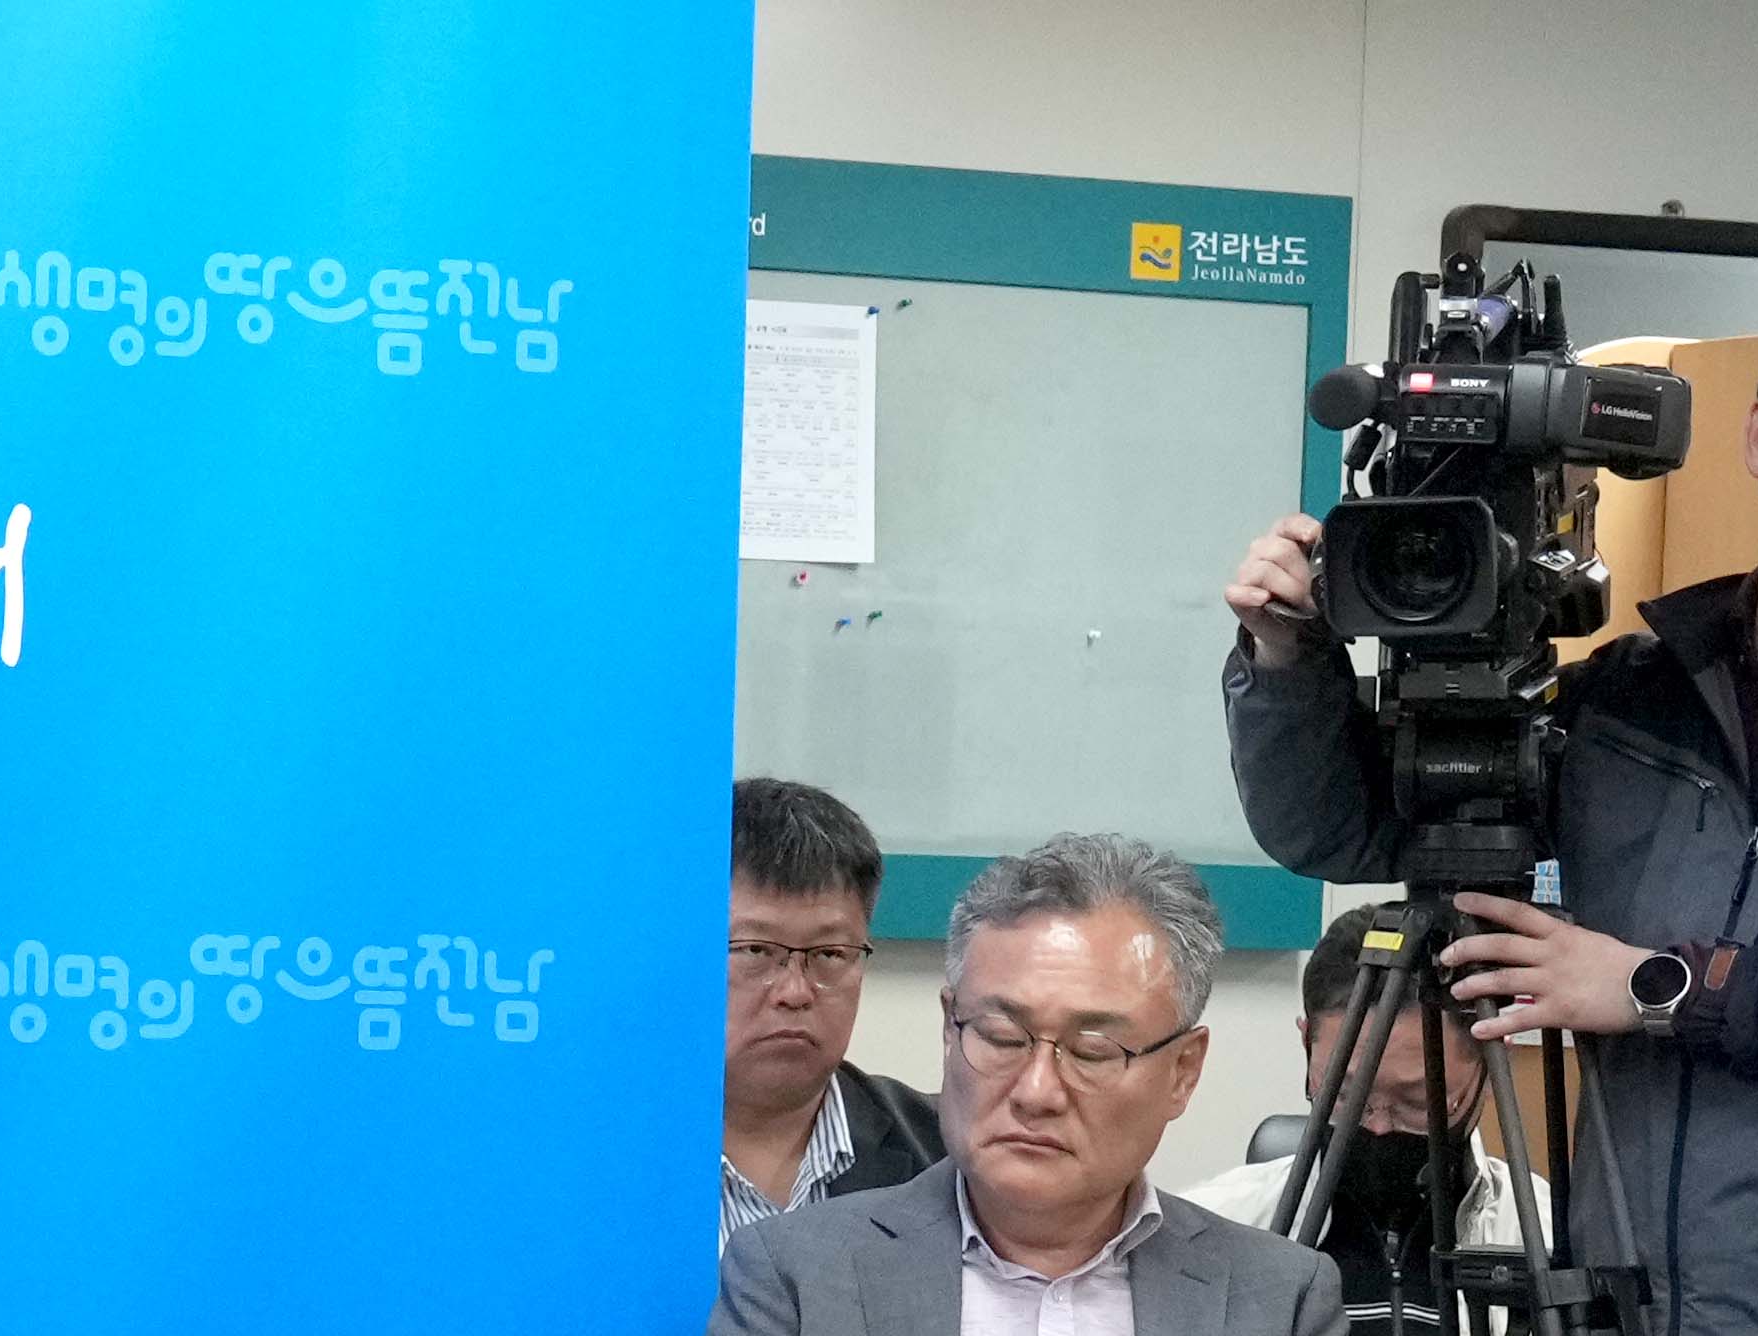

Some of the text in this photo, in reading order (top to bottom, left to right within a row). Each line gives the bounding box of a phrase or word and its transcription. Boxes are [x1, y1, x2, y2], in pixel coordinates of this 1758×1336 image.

[748, 212, 766, 236] d
[1188, 231, 1308, 265] 전라남도
[1191, 264, 1305, 285] JeollaNamdo
[1450, 378, 1490, 388] SONY
[1602, 405, 1612, 415] LG
